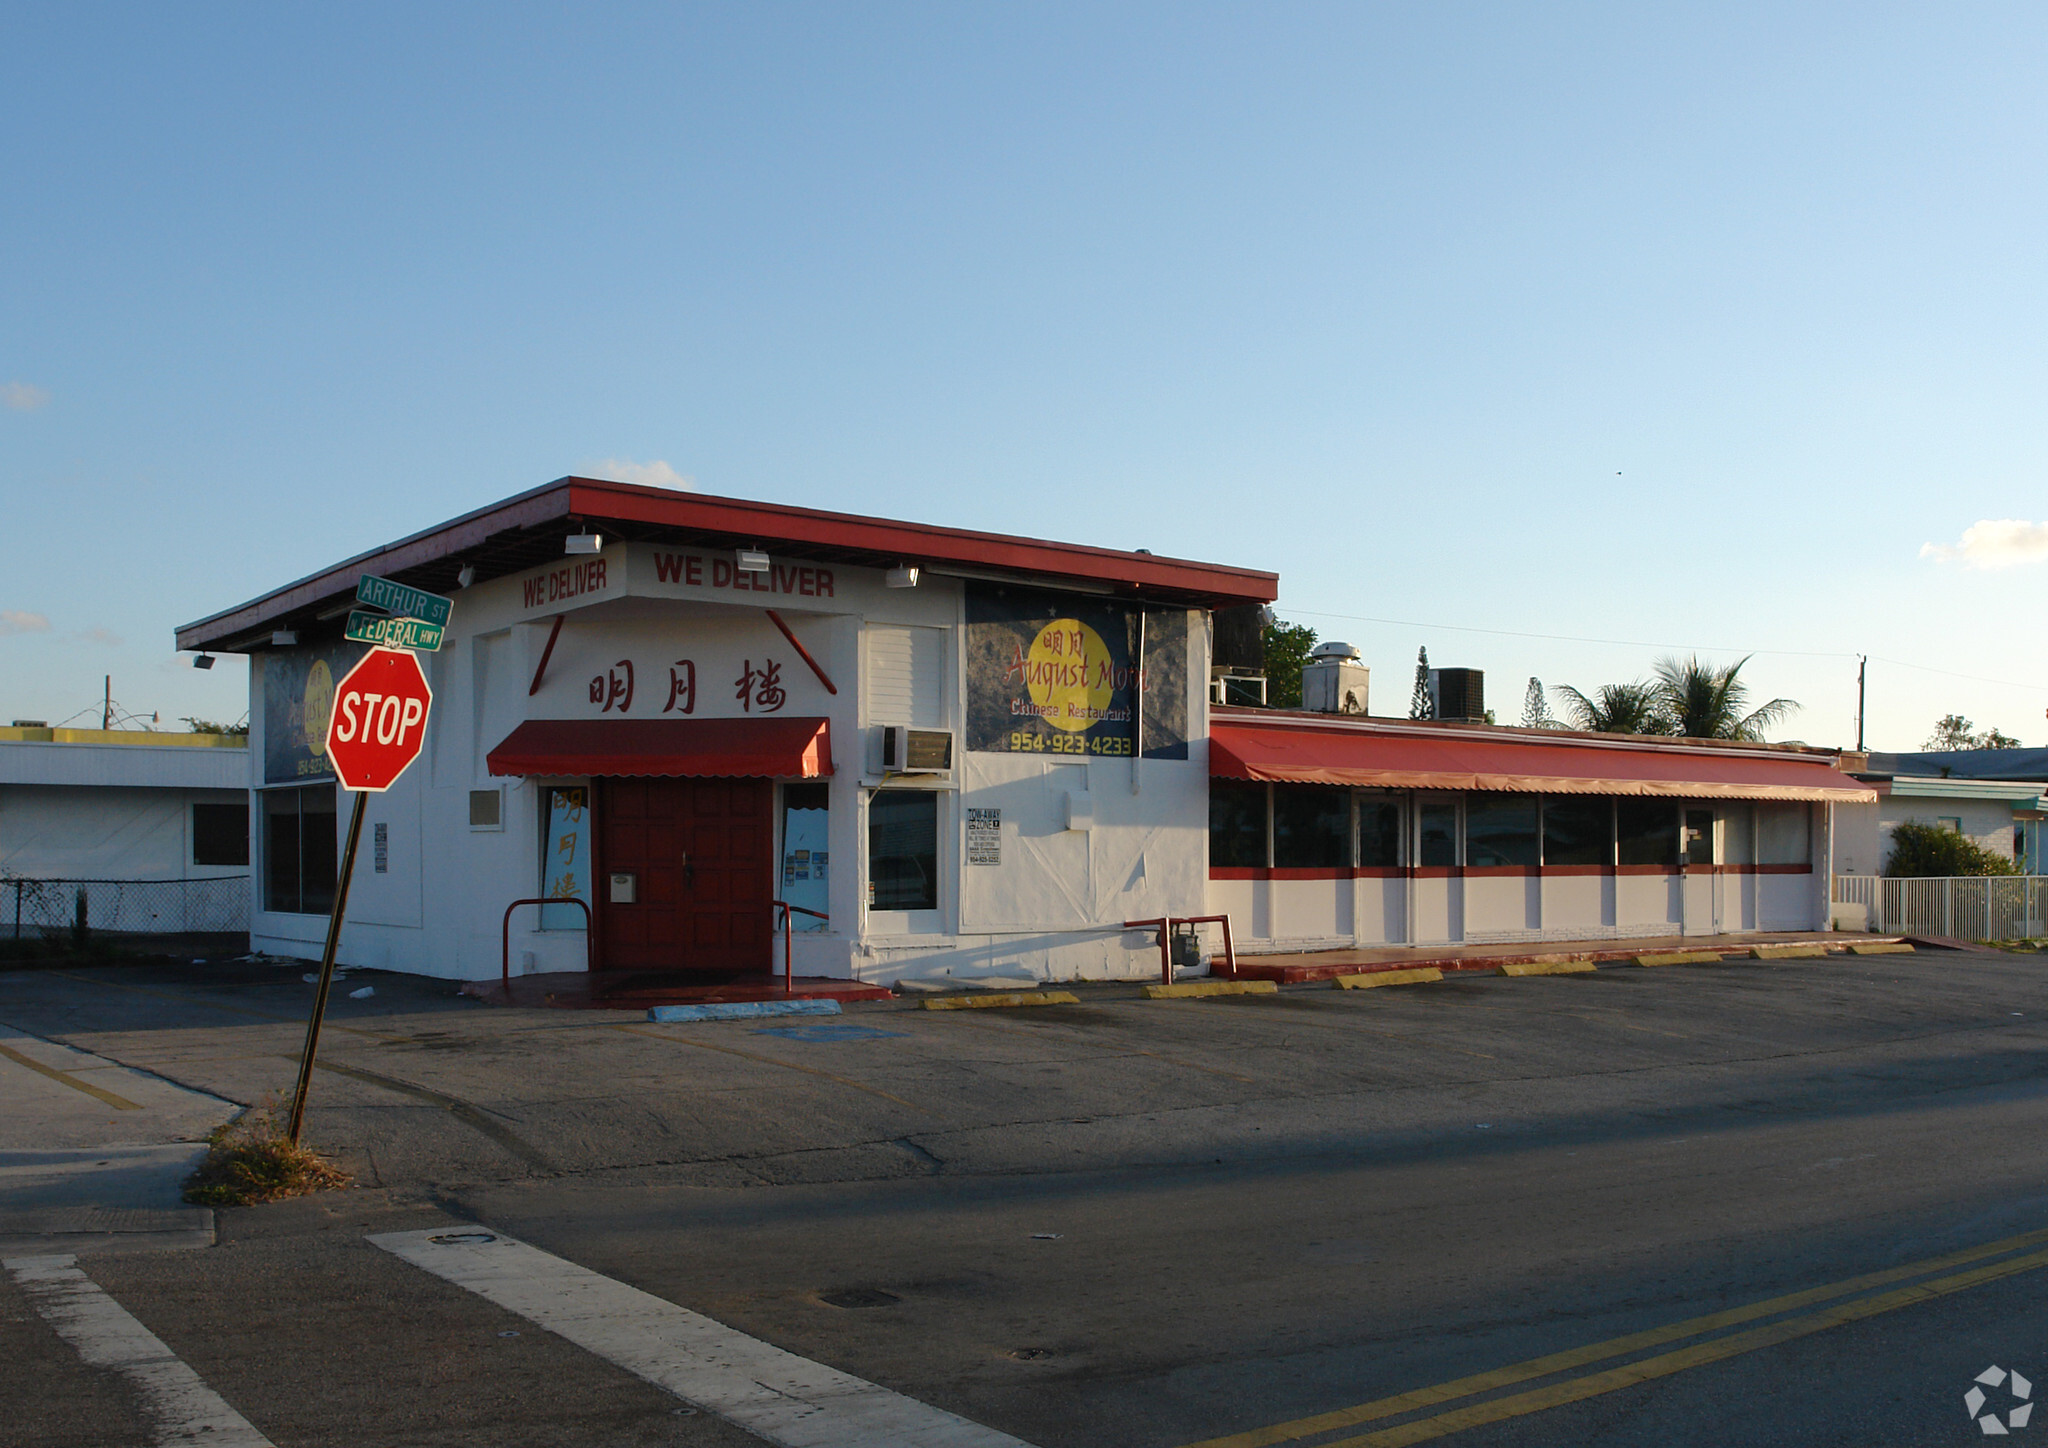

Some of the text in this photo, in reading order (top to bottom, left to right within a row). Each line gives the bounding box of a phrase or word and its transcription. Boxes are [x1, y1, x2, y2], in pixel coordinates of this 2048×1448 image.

[524, 558, 607, 608] WE DELIVER
[653, 552, 834, 598] WE DELIVER
[361, 579, 446, 619] ARTHUR ST
[358, 616, 418, 645] FEDERAL
[420, 629, 440, 645] HWY
[1003, 643, 1090, 703] August
[336, 691, 423, 746] STOP
[1010, 697, 1132, 722] Chinese Restaurant
[968, 808, 1001, 819] TOW-AWAY
[976, 819, 992, 830] ZONE
